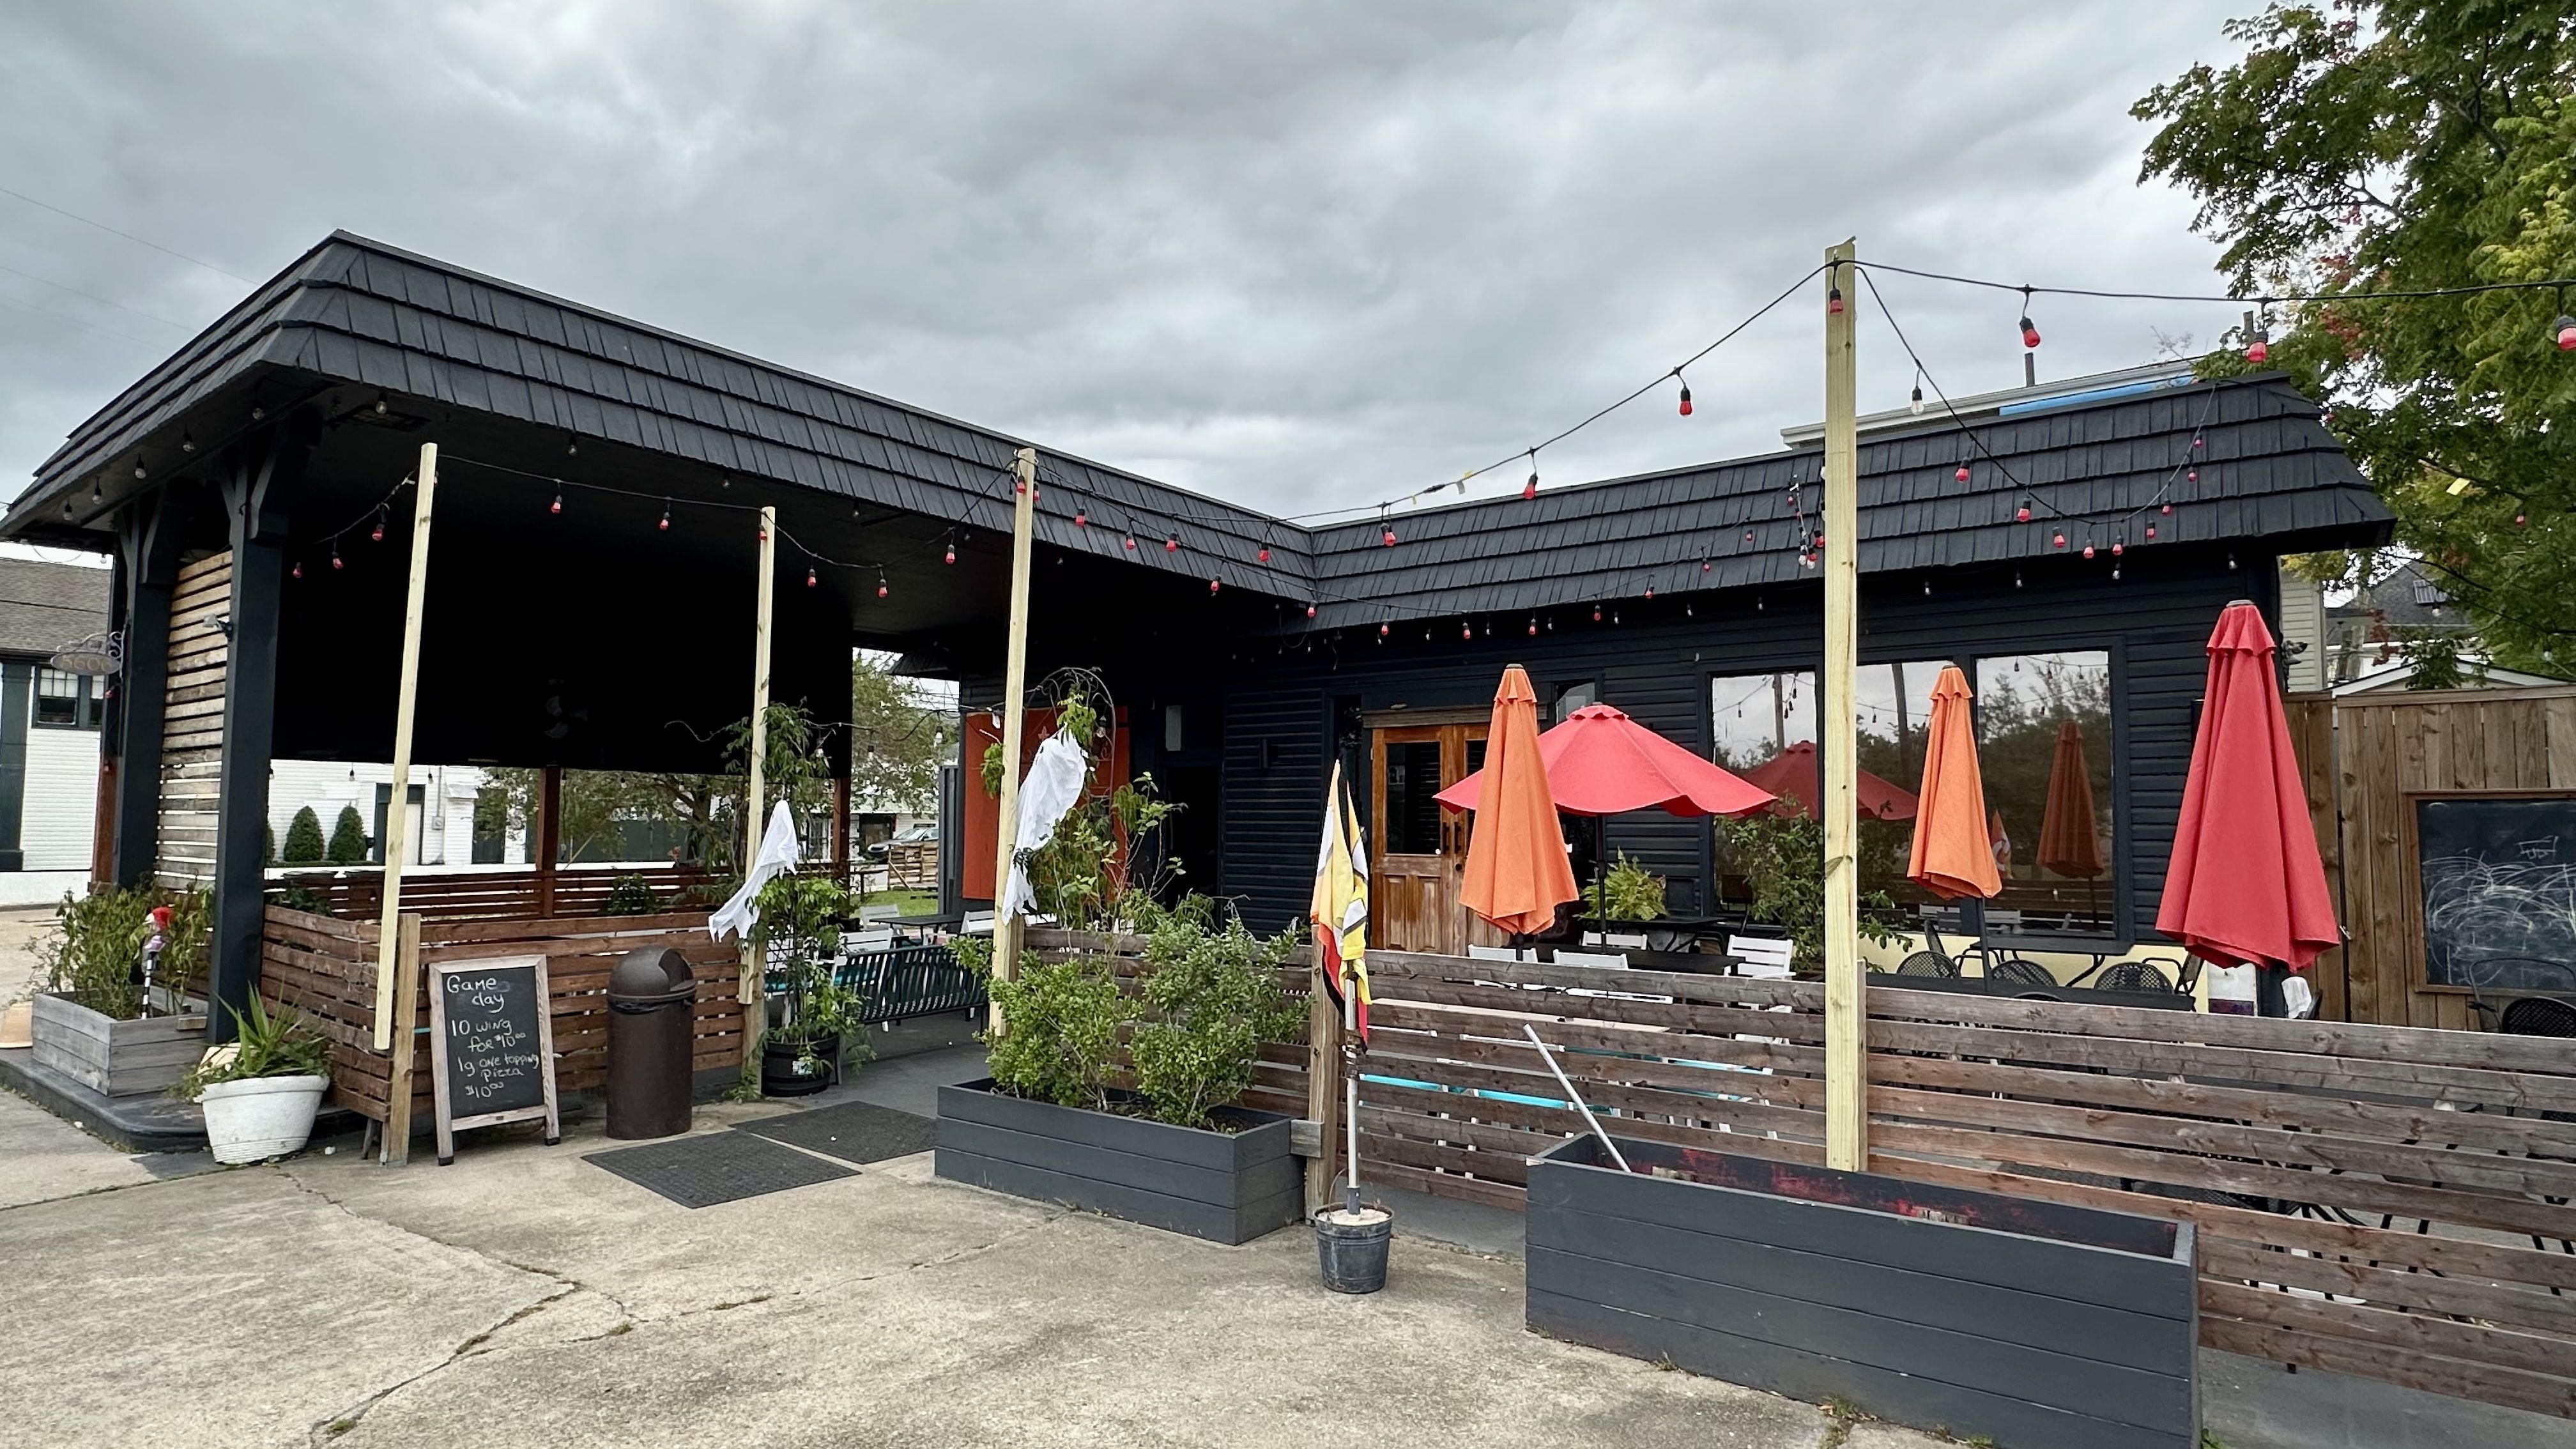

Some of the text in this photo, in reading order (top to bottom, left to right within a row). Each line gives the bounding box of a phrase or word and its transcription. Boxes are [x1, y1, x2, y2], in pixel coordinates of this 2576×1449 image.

[471, 992, 505, 1013] day
[451, 1020, 470, 1036] 10
[479, 1056, 502, 1068] one
[504, 1053, 539, 1070] topping
[480, 1068, 524, 1082] pizza
